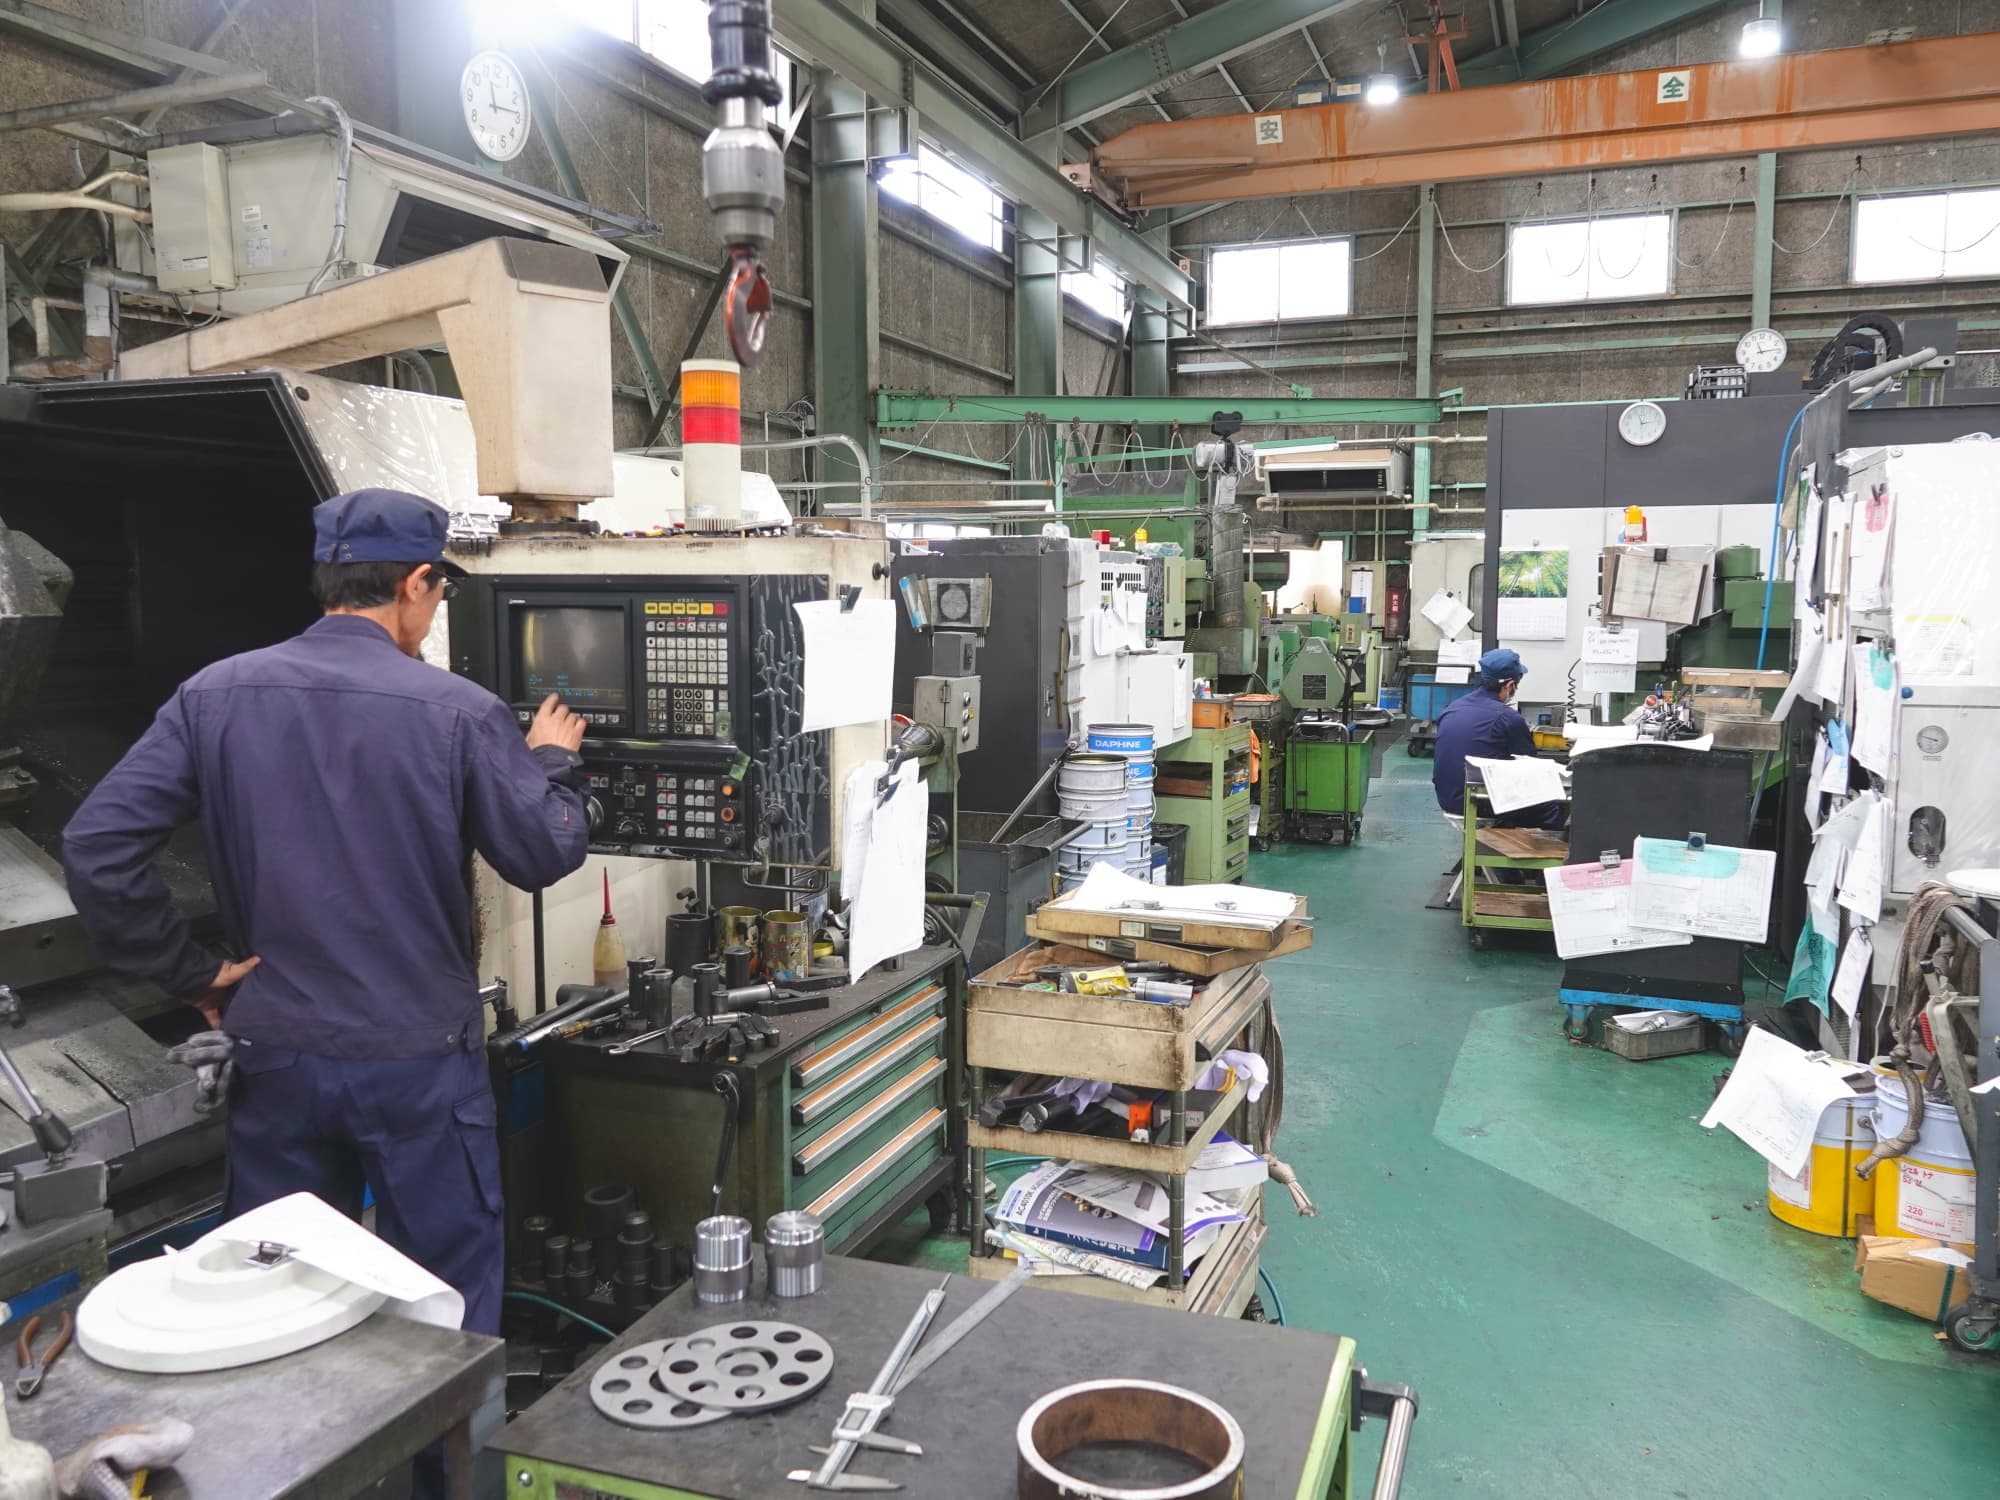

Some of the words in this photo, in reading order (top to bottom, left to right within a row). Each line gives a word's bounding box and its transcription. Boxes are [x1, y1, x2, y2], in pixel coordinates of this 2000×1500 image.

[482, 63, 490, 79] 11
[493, 63, 504, 80] 12
[471, 71, 481, 87] 10
[466, 87, 473, 103] 9
[511, 91, 518, 105] 2
[471, 108, 478, 122] 8
[1260, 119, 1279, 141] 安
[1662, 75, 1685, 99] 全
[509, 127, 515, 140] 4
[500, 135, 507, 149] 5
[1095, 739, 1142, 749] DAPHNE
[1907, 1205, 1923, 1216] 220
